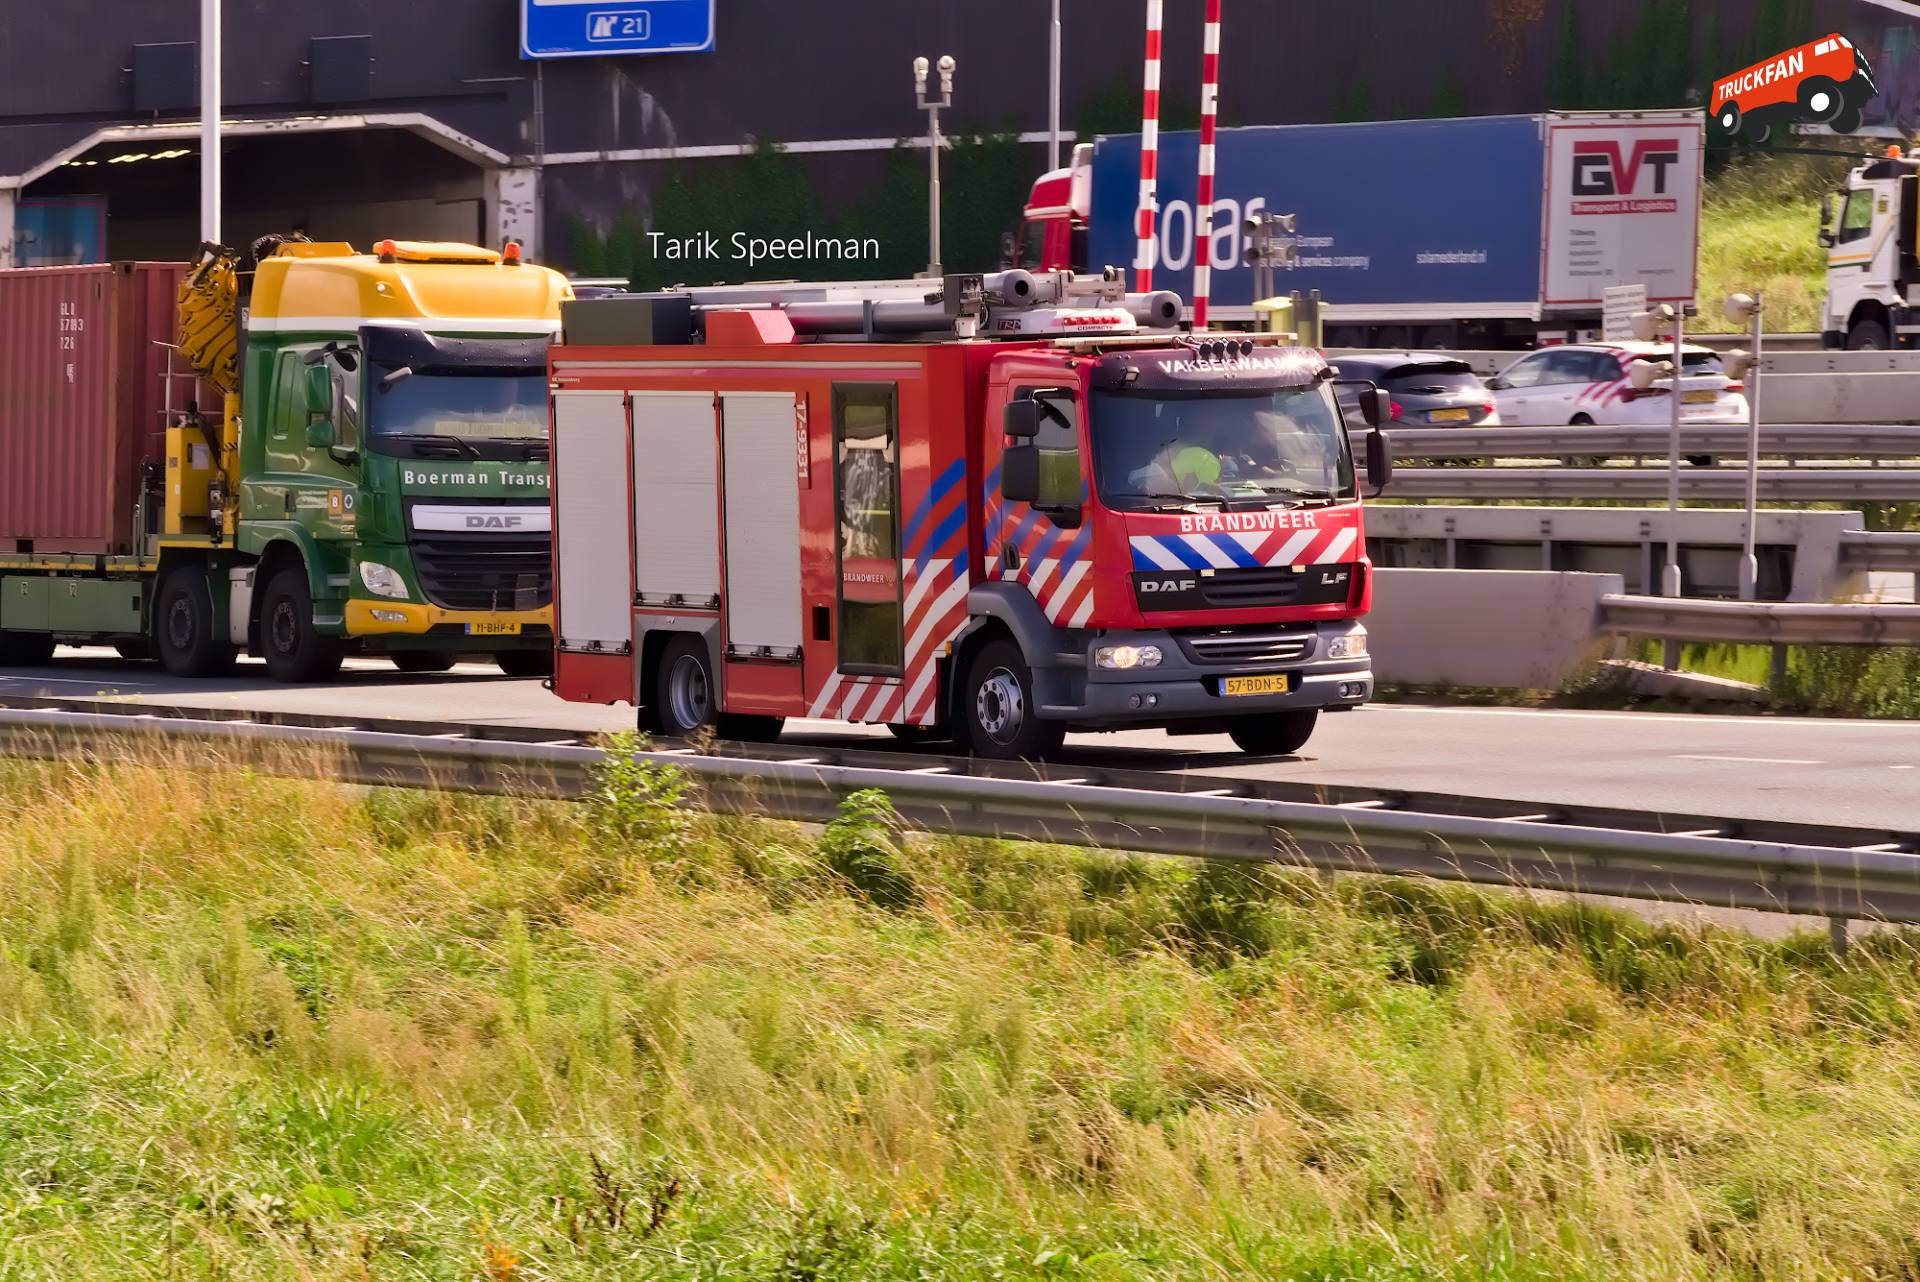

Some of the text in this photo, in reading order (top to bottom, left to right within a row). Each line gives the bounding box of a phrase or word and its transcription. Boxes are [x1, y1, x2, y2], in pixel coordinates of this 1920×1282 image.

[622, 17, 643, 34] 21
[1572, 139, 1679, 195] GVT
[797, 400, 809, 478] 17-9331
[404, 470, 489, 485] Boerman
[466, 516, 522, 527] DAF
[1180, 511, 1316, 532] BRANDWEER
[843, 573, 884, 583] BRANDWEER
[1320, 573, 1349, 585] LF
[1140, 580, 1196, 592] DAF
[1227, 678, 1284, 693] 57-BDN-5
